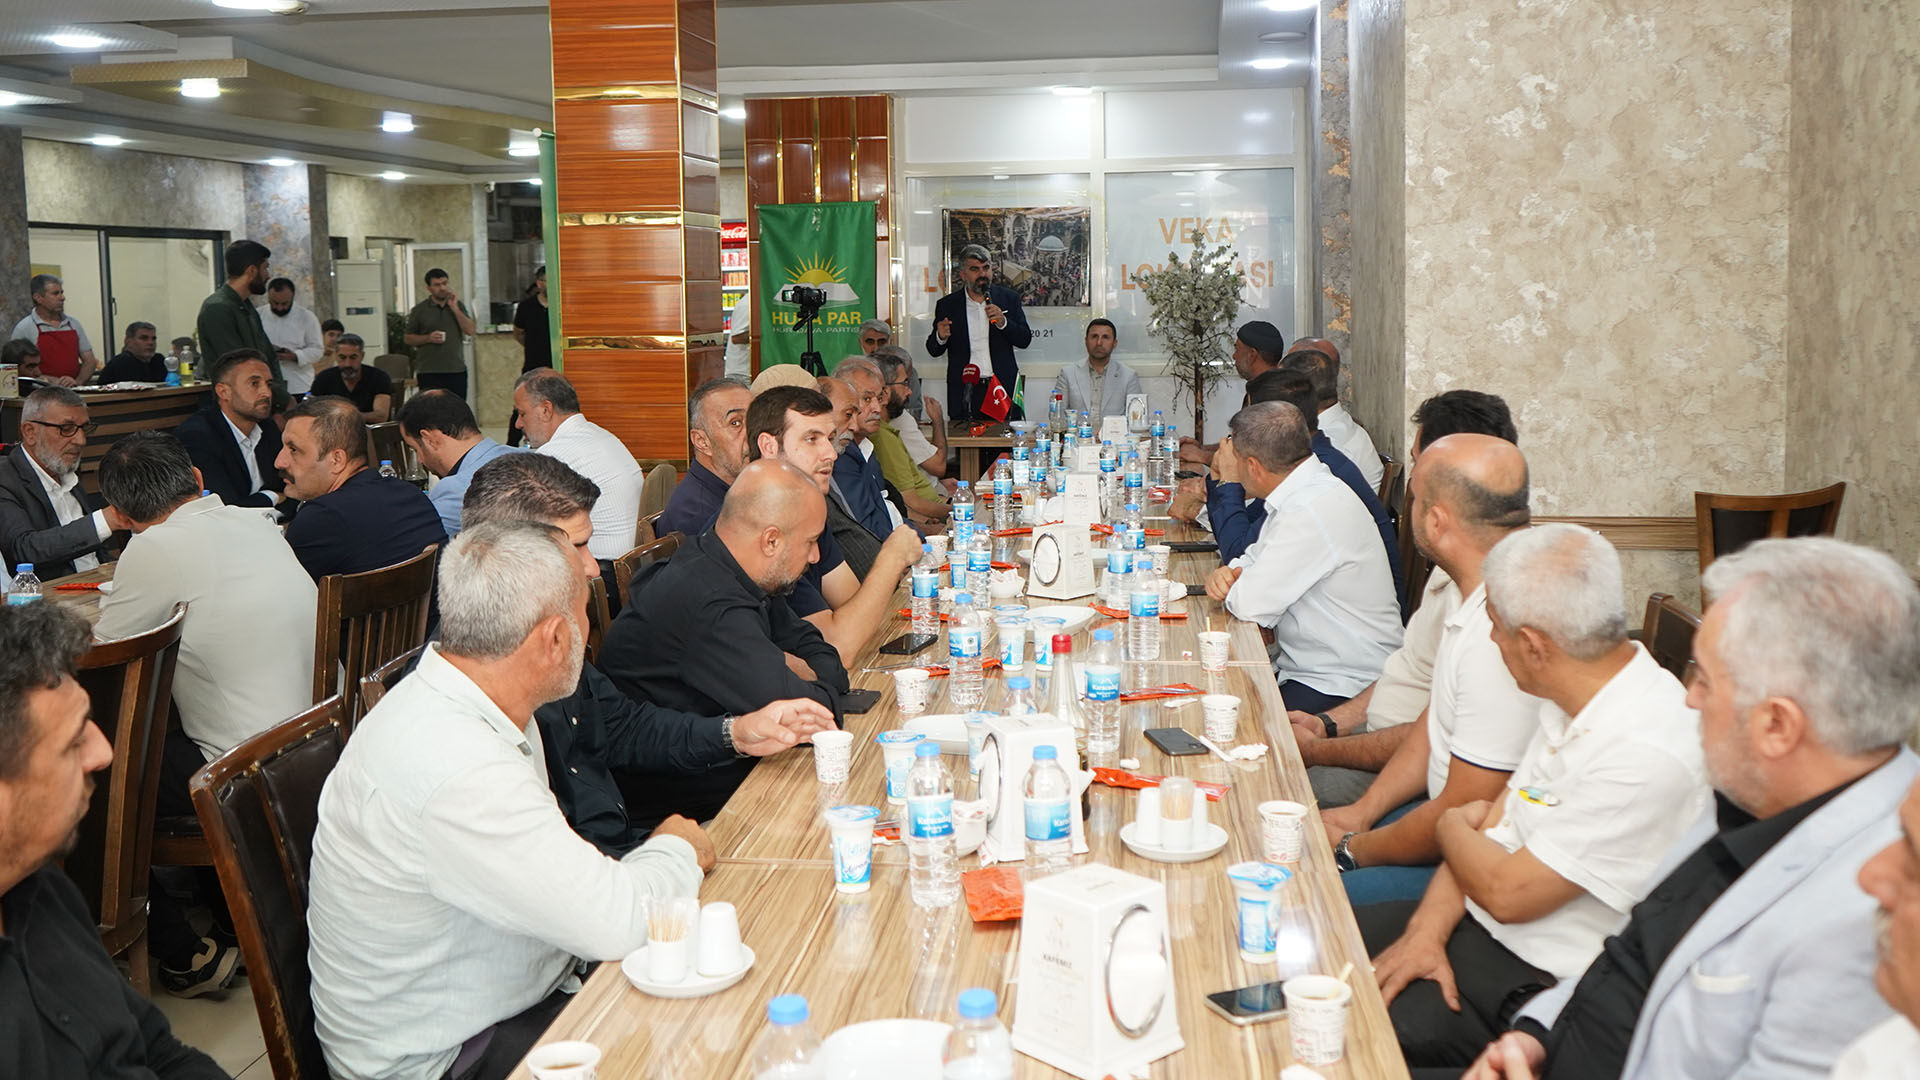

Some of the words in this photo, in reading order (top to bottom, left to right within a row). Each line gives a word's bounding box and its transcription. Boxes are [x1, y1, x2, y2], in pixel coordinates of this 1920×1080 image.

[1158, 215, 1236, 245] VEKA
[827, 311, 862, 325] PAR
[1042, 328, 1054, 338] 21
